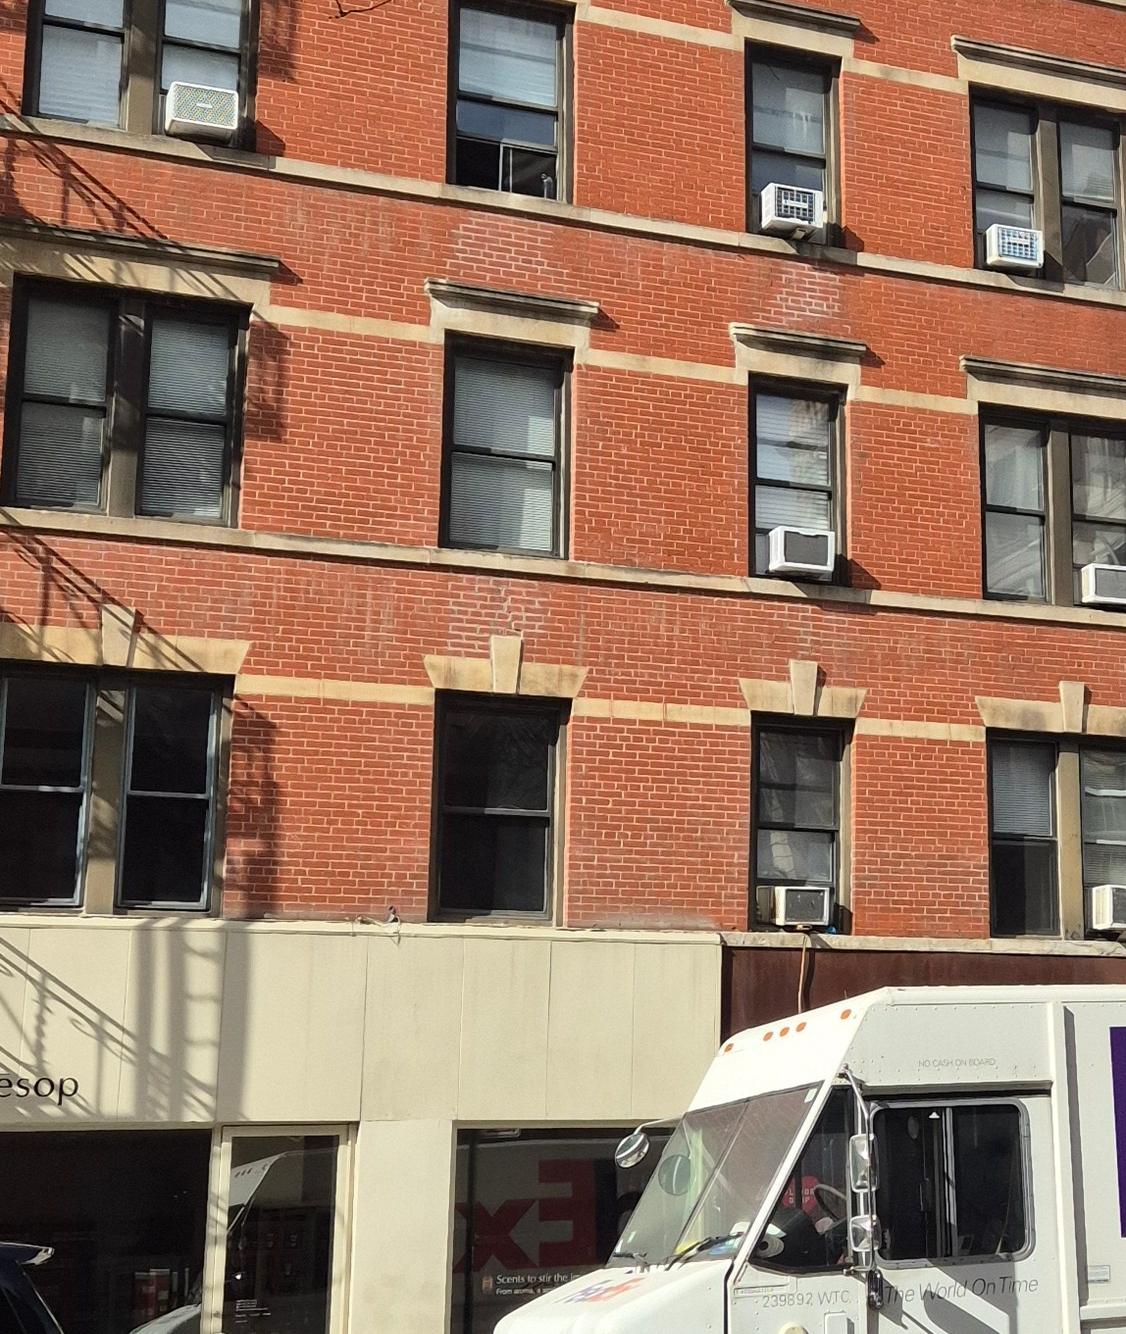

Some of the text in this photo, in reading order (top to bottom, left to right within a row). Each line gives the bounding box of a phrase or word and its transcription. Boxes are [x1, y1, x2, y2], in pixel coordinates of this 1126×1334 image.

[918, 1059, 931, 1068] NO
[932, 1058, 954, 1067] CASH
[954, 1058, 967, 1067] ON
[496, 1274, 525, 1285] Scents
[527, 1274, 537, 1283] to
[538, 1273, 551, 1283] stir
[553, 1273, 569, 1282] the
[885, 1275, 1039, 1304] The World On Time
